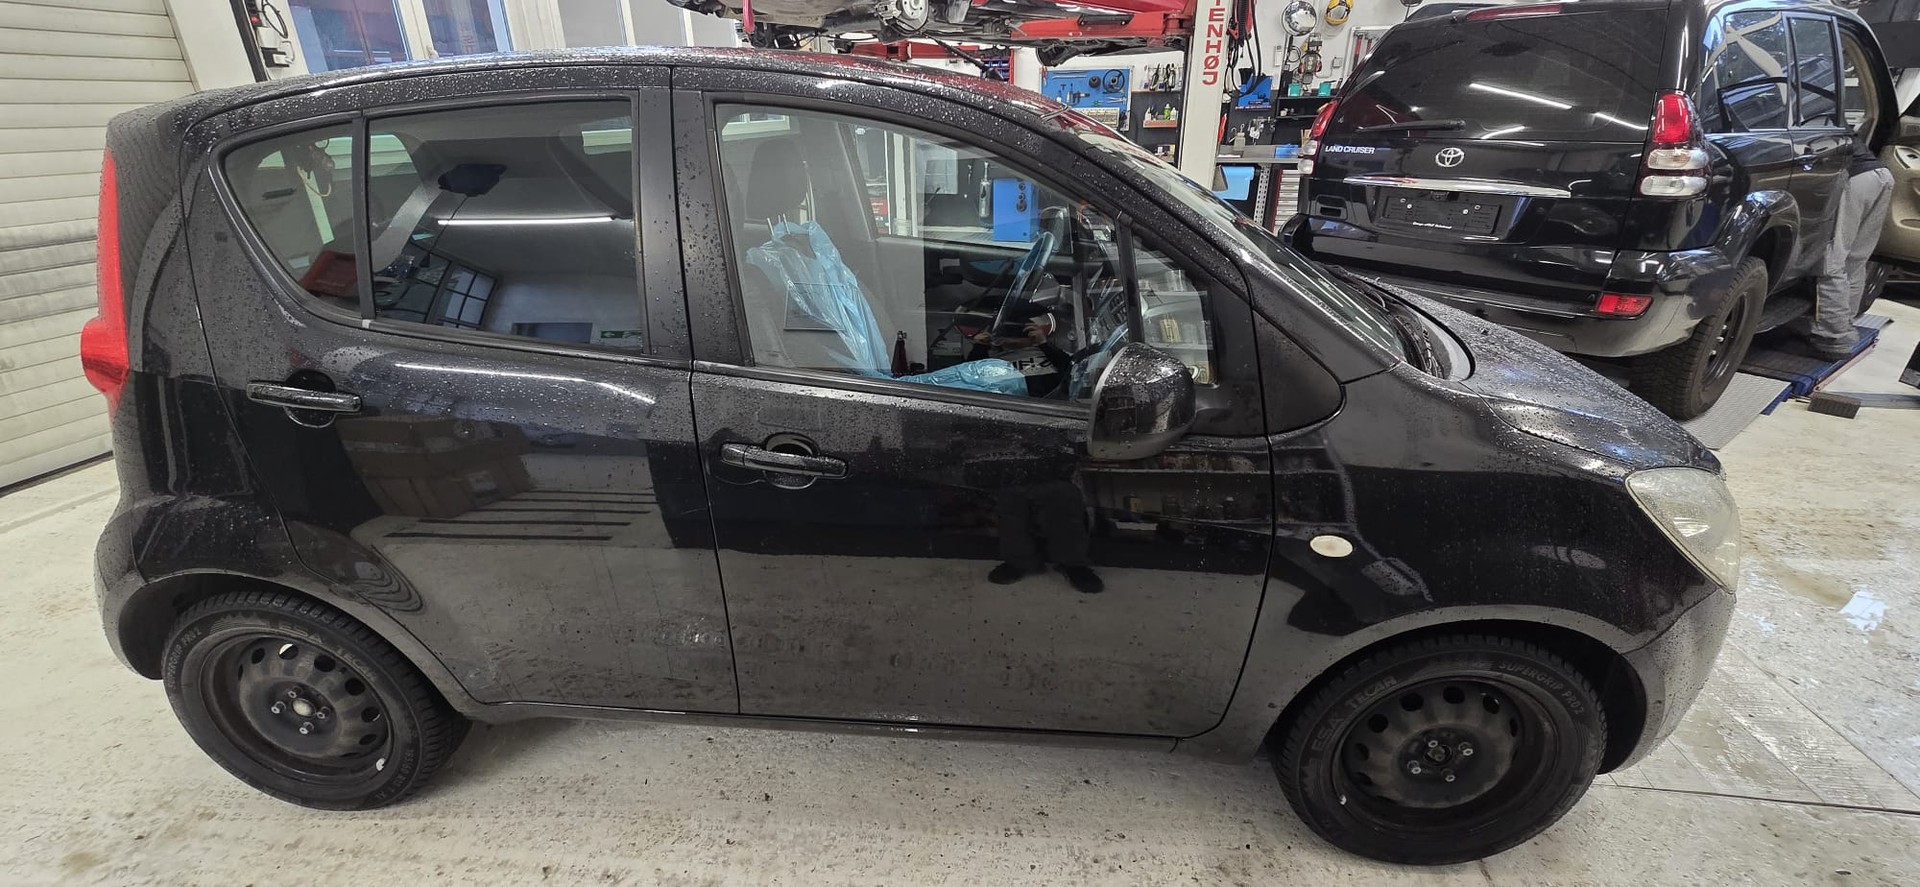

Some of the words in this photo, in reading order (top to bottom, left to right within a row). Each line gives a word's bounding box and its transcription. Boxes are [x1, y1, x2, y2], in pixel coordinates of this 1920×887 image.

[1325, 145, 1343, 153] LAND
[1343, 146, 1375, 154] CRUISER
[1498, 661, 1565, 691] SUPERGRIP
[1311, 716, 1346, 752] ESA
